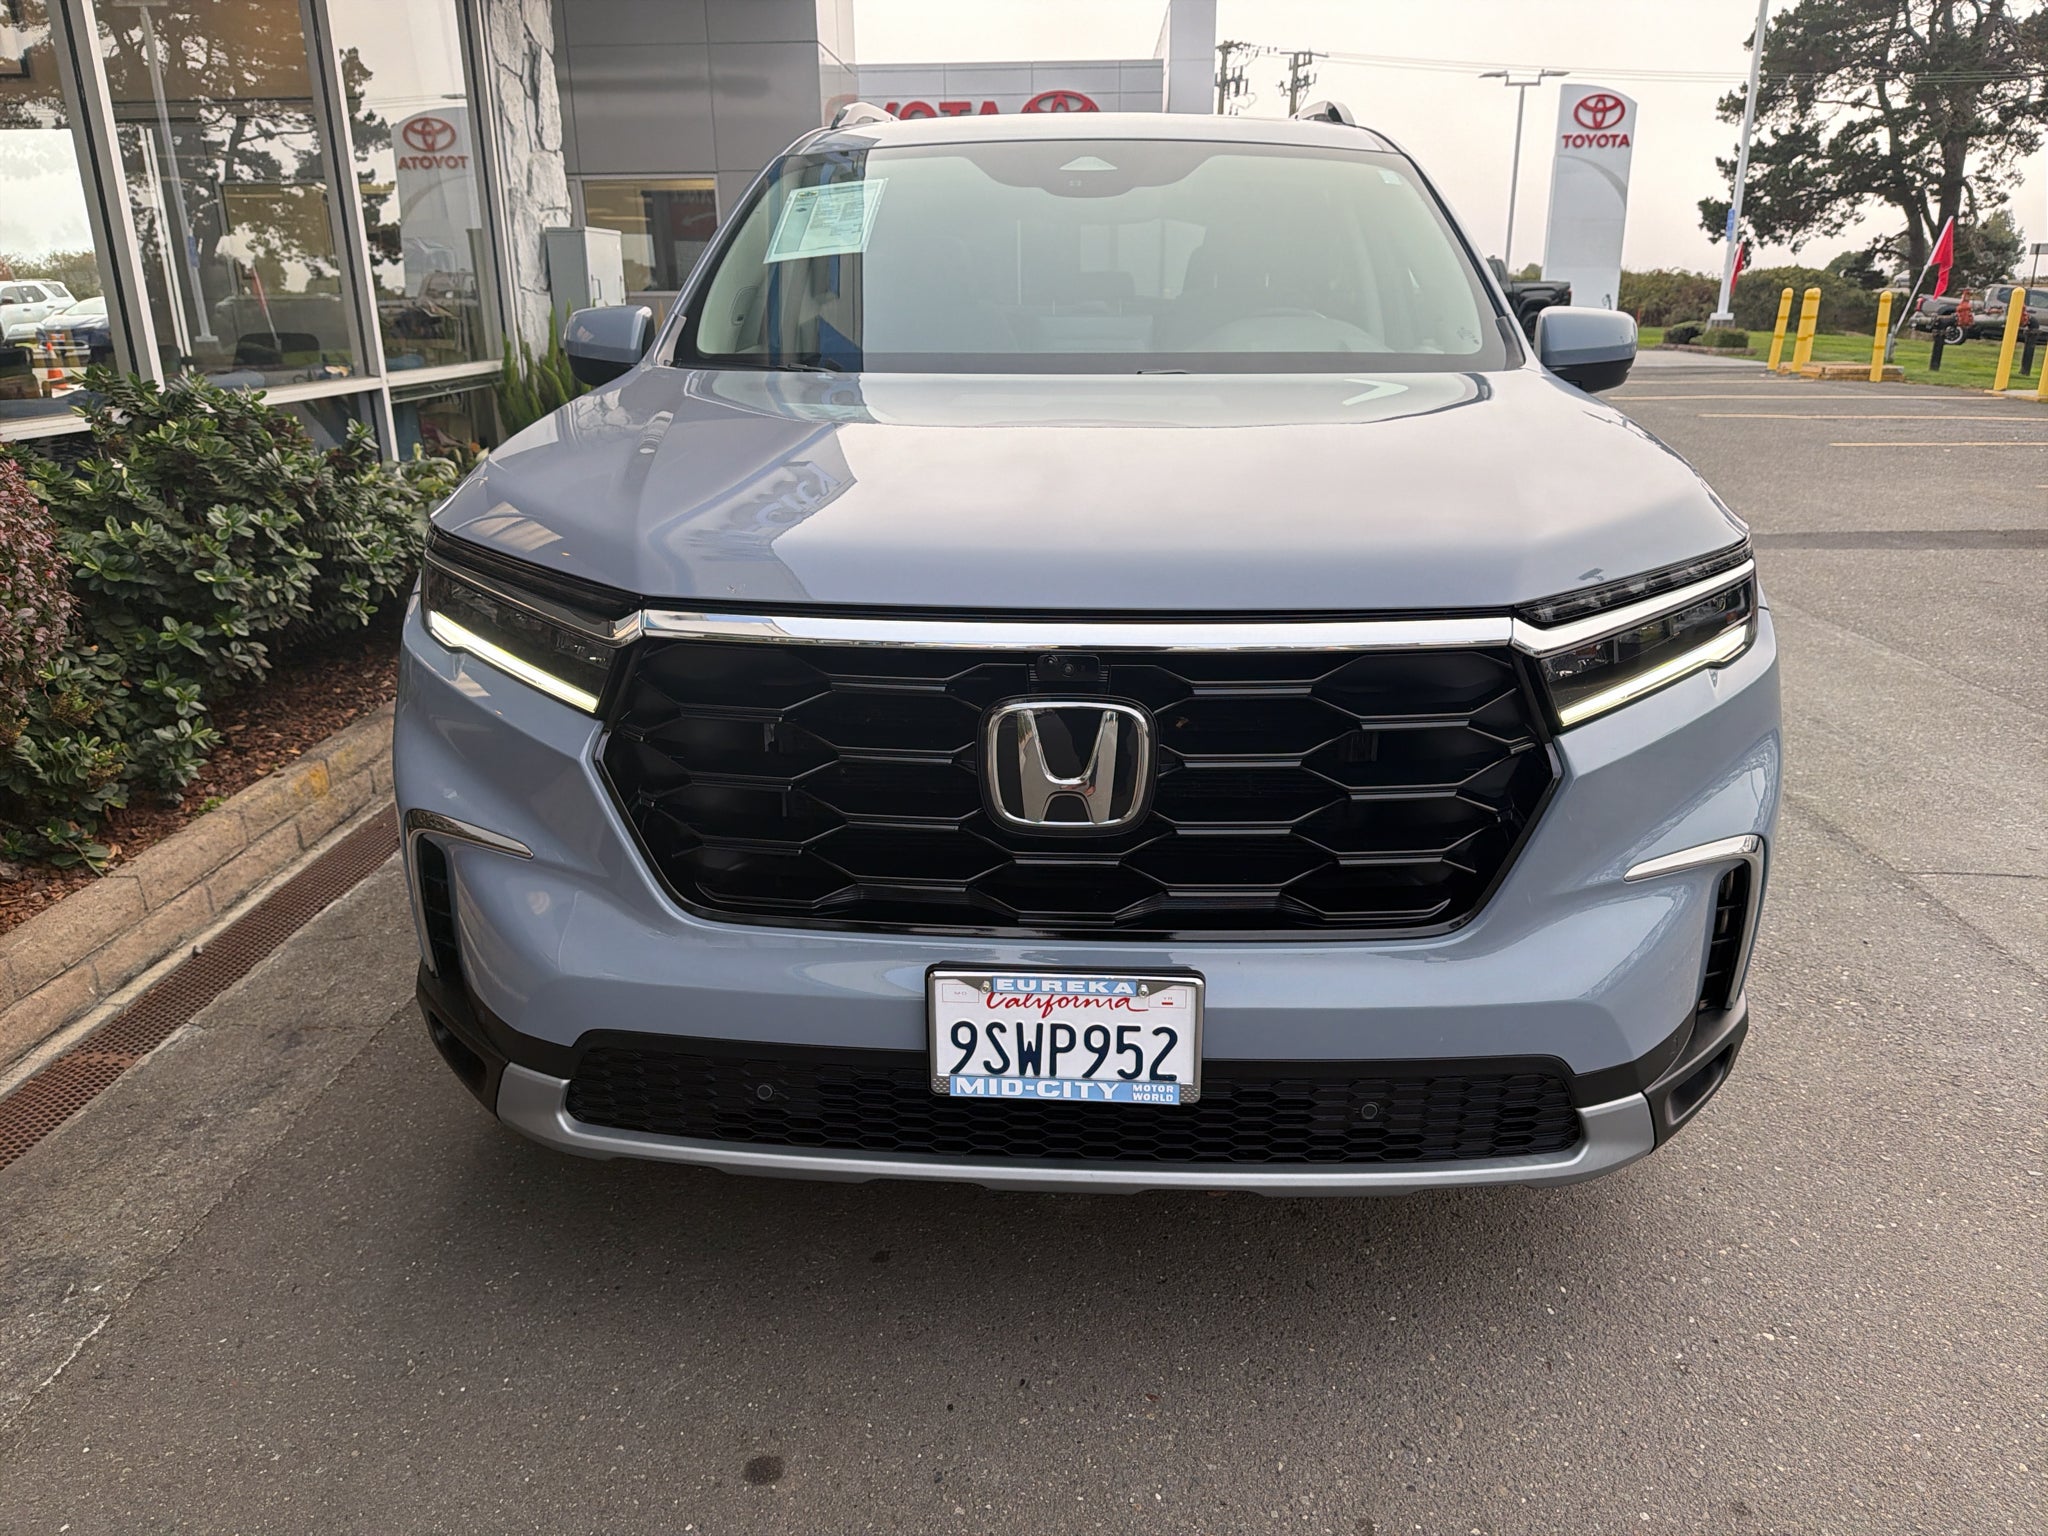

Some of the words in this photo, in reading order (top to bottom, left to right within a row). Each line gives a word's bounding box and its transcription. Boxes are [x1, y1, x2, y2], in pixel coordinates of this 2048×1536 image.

[1562, 134, 1630, 149] TOYOTA
[996, 979, 1134, 994] EUREKA
[986, 992, 1149, 1018] California
[950, 1020, 1178, 1081] 9SWP952
[955, 1077, 1119, 1100] MID-CITY
[1132, 1084, 1174, 1093] MOTOR
[1132, 1092, 1174, 1102] WORLD
